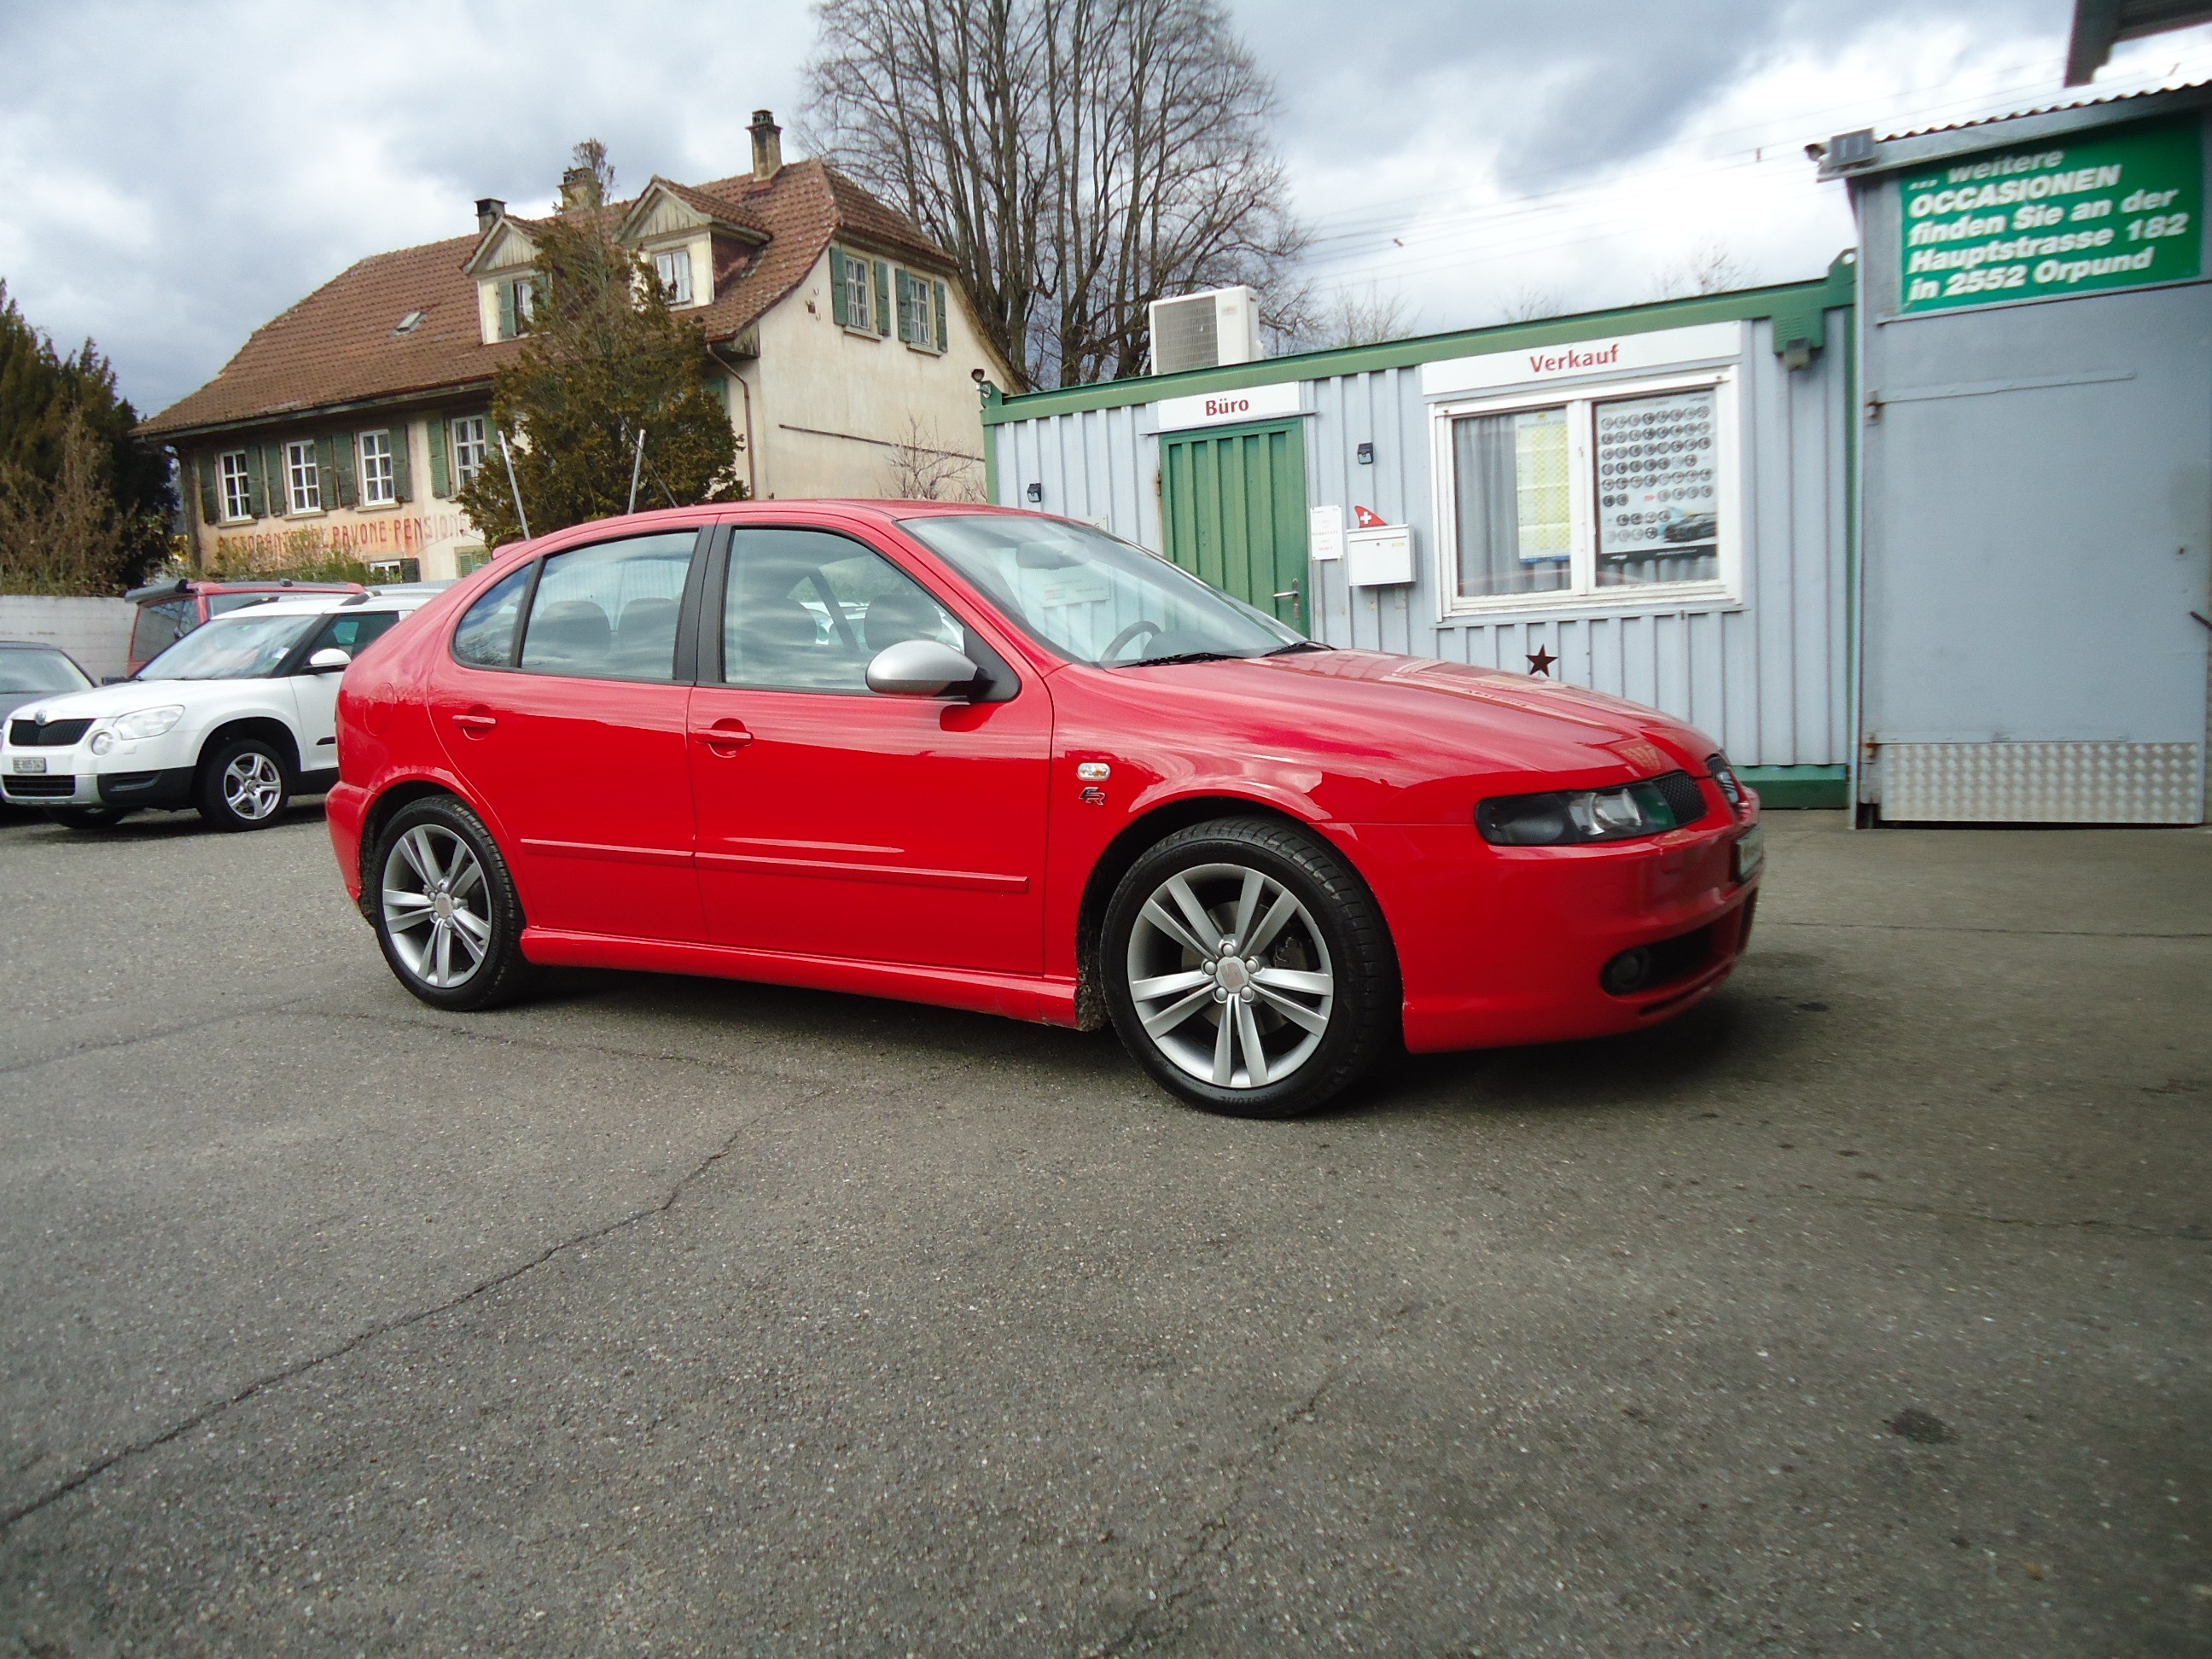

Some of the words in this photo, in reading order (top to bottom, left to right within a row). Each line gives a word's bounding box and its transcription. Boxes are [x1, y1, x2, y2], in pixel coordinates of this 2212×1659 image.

[1947, 149, 2064, 182] weitere
[1908, 164, 2122, 217] OCCASIONEN
[1906, 210, 2007, 247] finden
[2012, 204, 2065, 231] Sie
[2069, 198, 2113, 222] an
[2120, 187, 2180, 214] der
[1906, 225, 2116, 275] Hauptstrasse
[2125, 212, 2191, 242] 182
[1907, 276, 1941, 301] in
[1941, 265, 2029, 298] 2552
[2033, 246, 2156, 286] Orpund
[1529, 343, 1620, 373] Verkauf
[1205, 397, 1250, 417] Büro
[332, 520, 387, 548] PAVONE
